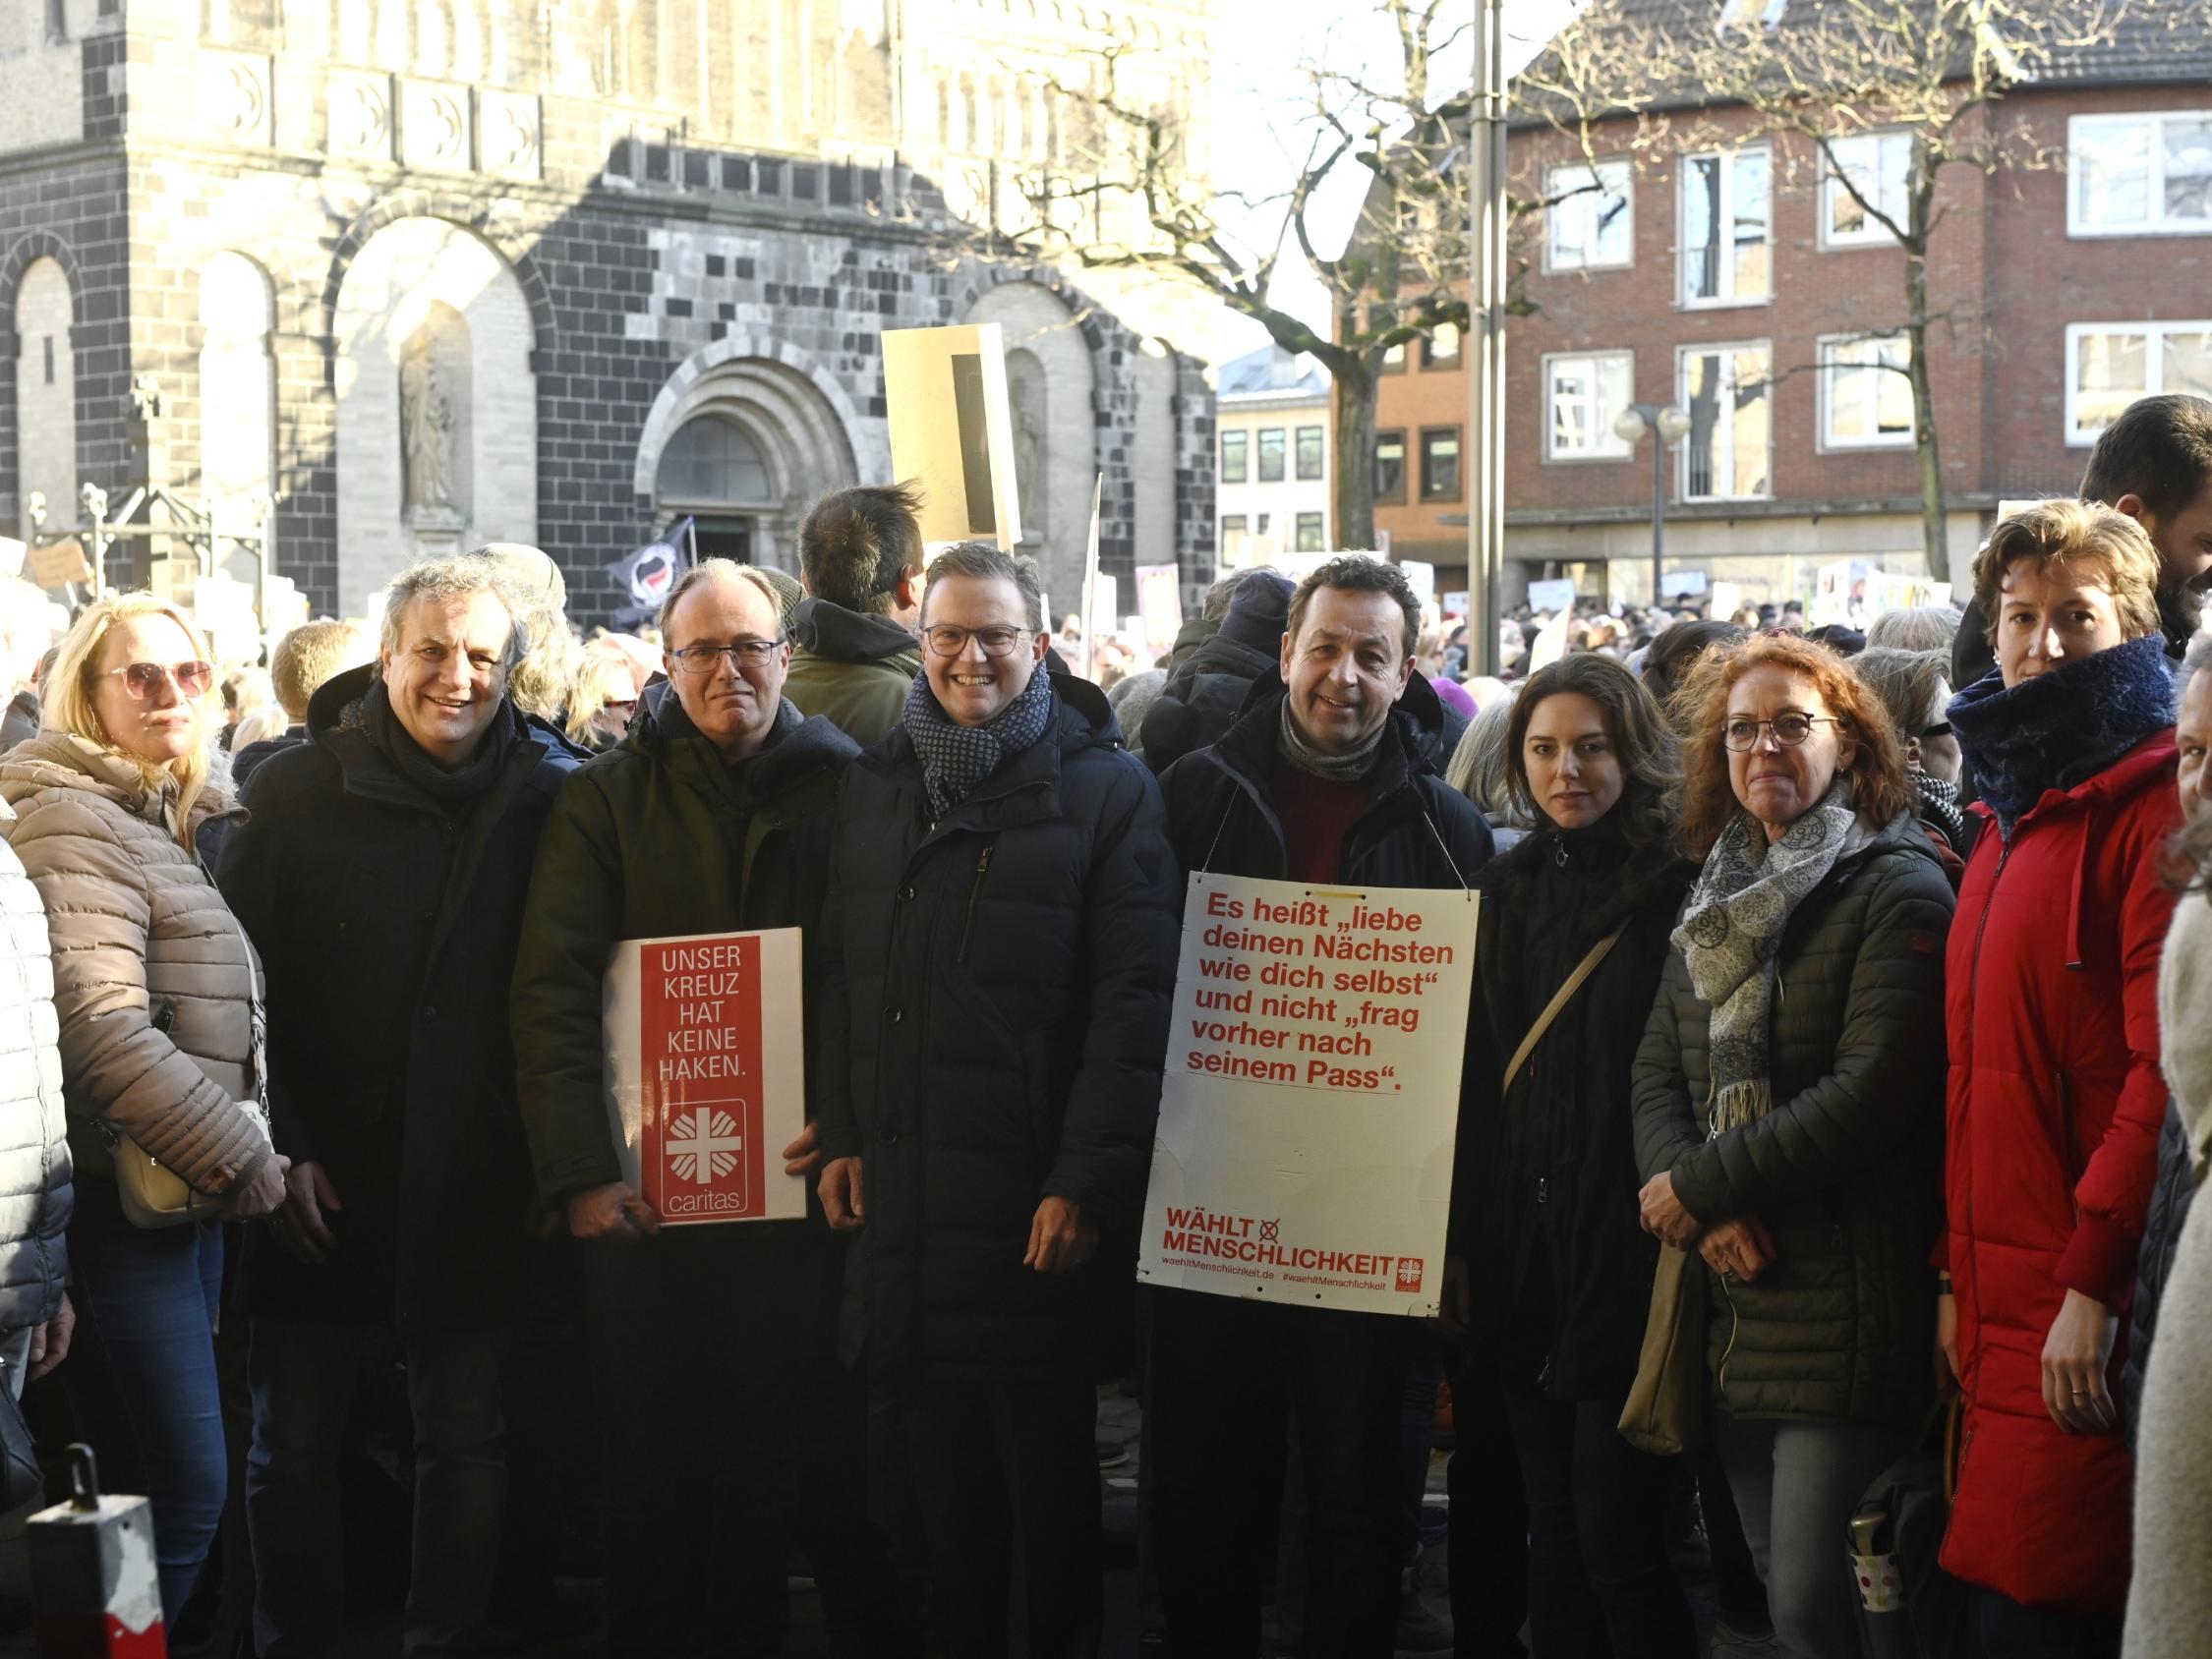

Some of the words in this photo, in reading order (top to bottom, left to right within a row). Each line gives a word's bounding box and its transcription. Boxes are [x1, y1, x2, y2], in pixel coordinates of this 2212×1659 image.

[1207, 892, 1244, 919] Es
[1252, 897, 1329, 927] heißt
[1337, 905, 1423, 933] „liebe
[662, 944, 741, 972] UNSER
[1203, 924, 1304, 956] deinen
[1313, 934, 1454, 964] Nächsten
[665, 973, 739, 1000] KREUZ
[1199, 956, 1251, 982] wie
[1260, 961, 1324, 990] dich
[1333, 969, 1437, 996] selbst“
[679, 1001, 725, 1025] HAT
[1195, 989, 1252, 1014] und
[1261, 994, 1337, 1022] nicht
[1344, 1000, 1420, 1033] „frag
[668, 1027, 737, 1054] KEINE
[1192, 1019, 1290, 1049] vorher
[1298, 1031, 1371, 1057] nach
[659, 1055, 746, 1081] HAKEN.
[1187, 1051, 1297, 1082] seinem
[669, 1188, 740, 1213] caritas
[1166, 1206, 1254, 1238] WÄHLT
[1163, 1230, 1394, 1276] MENSCHLICHKEIT
